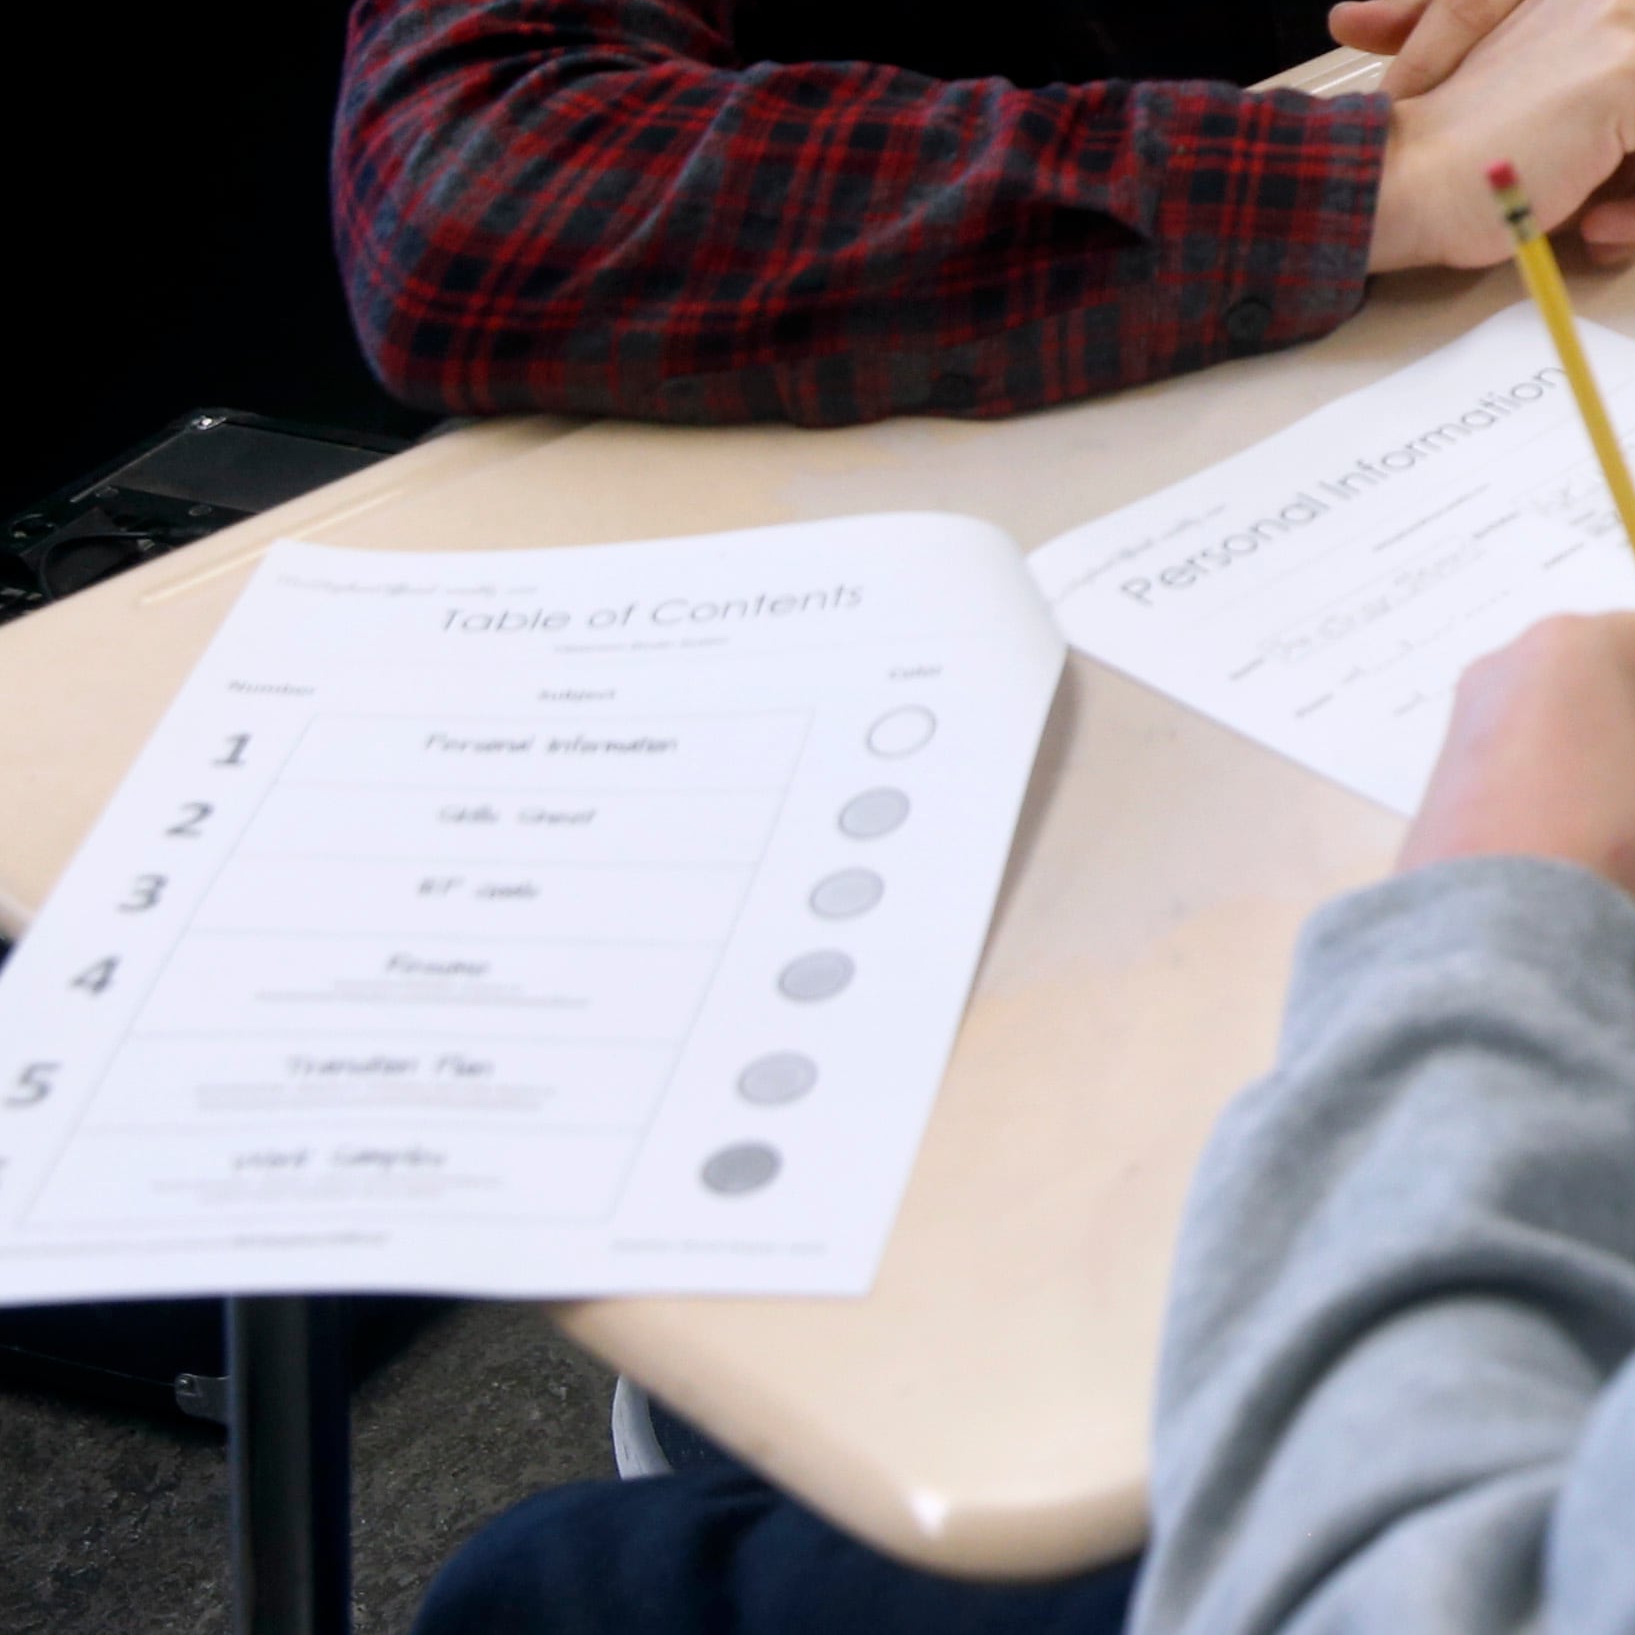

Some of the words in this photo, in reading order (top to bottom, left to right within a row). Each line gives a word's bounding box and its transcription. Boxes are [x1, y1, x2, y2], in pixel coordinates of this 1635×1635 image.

[1118, 492, 1334, 607] Personal
[1318, 364, 1570, 502] Information
[442, 604, 572, 635] Table
[586, 600, 637, 629] of
[651, 580, 865, 627] Contents
[210, 732, 253, 768] 1
[424, 732, 534, 755] Personal
[546, 732, 680, 755] Information
[164, 800, 215, 839] 2
[116, 873, 168, 913] 3
[68, 954, 121, 998] 4
[3, 1060, 60, 1109] 5
